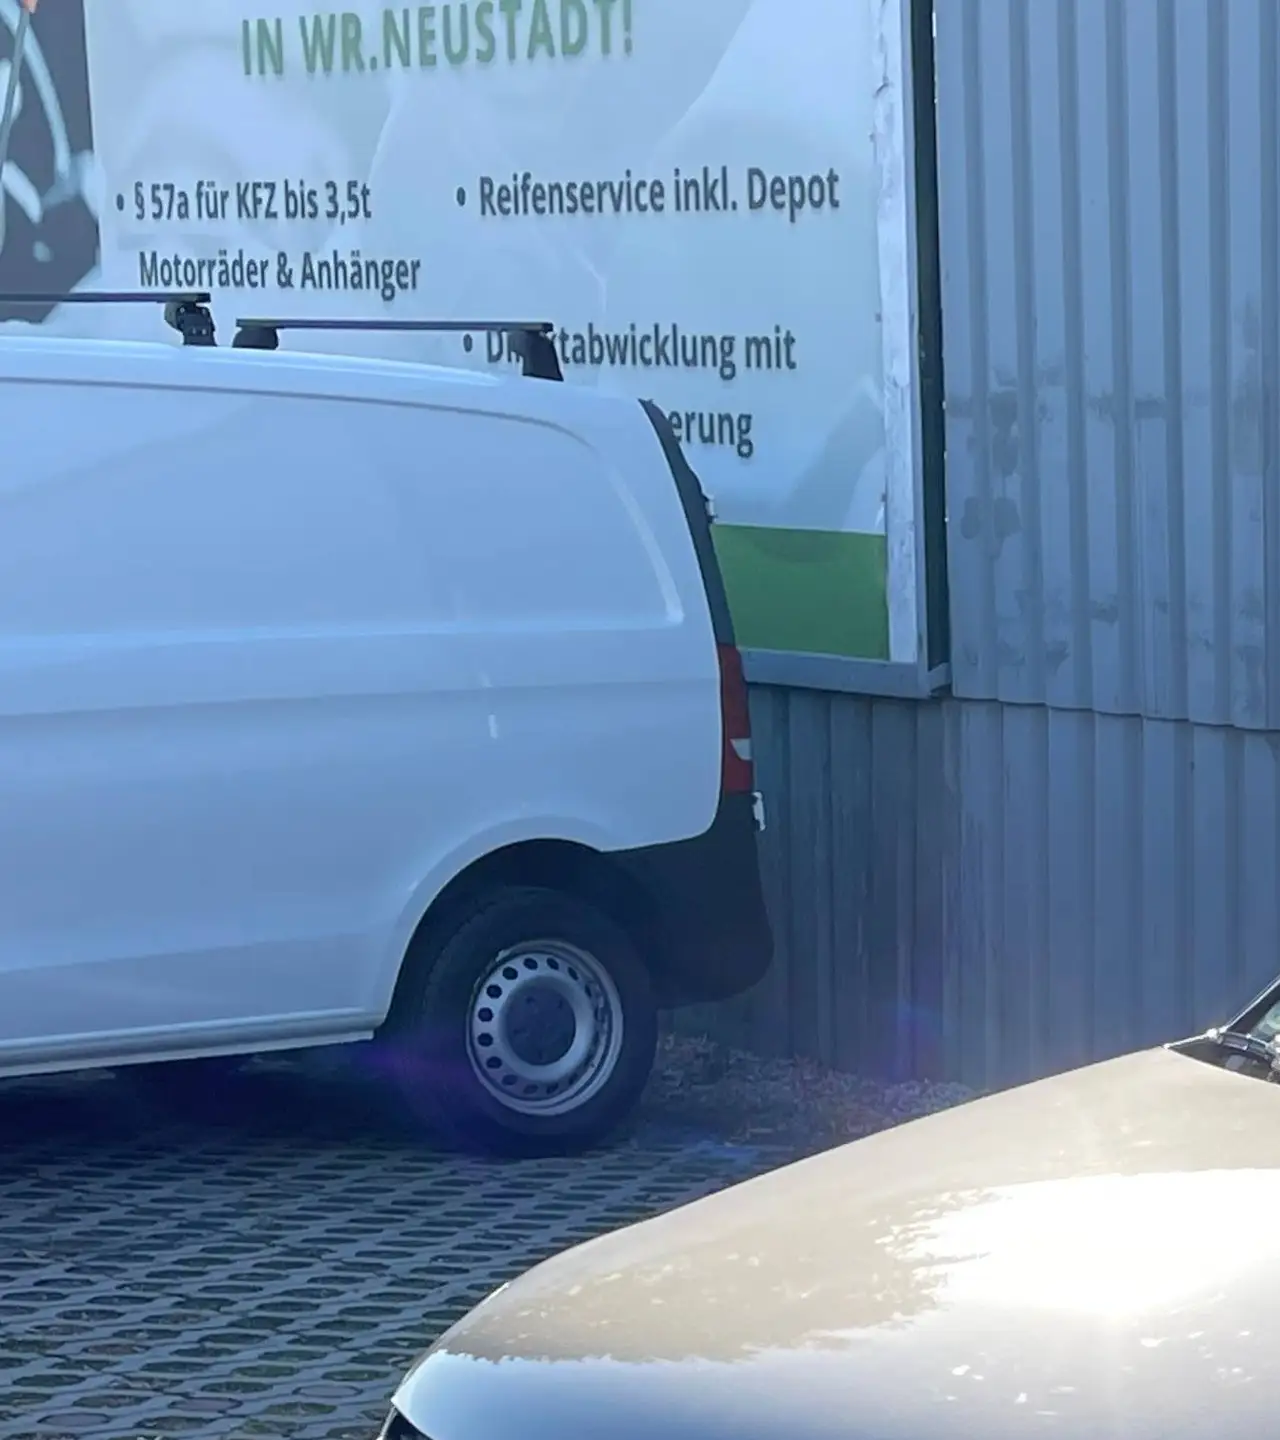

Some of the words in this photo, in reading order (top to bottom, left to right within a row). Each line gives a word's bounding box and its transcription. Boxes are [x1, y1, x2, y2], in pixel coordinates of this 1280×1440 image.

[242, 17, 285, 76] IN
[299, 0, 633, 74] WR.NEUSTADT!
[151, 183, 190, 220] 57a
[196, 180, 230, 219] für
[236, 182, 278, 219] KFZ
[284, 179, 319, 219] bis
[325, 180, 372, 225] 3,5t
[479, 169, 666, 217] Reifenservice
[673, 165, 738, 212] inkl.
[747, 167, 841, 223] Depot
[139, 249, 269, 289] Motorräder
[276, 251, 295, 289] &
[301, 249, 421, 301] Anhänger
[486, 322, 736, 381] Dtabwicklung
[744, 325, 798, 371] mit
